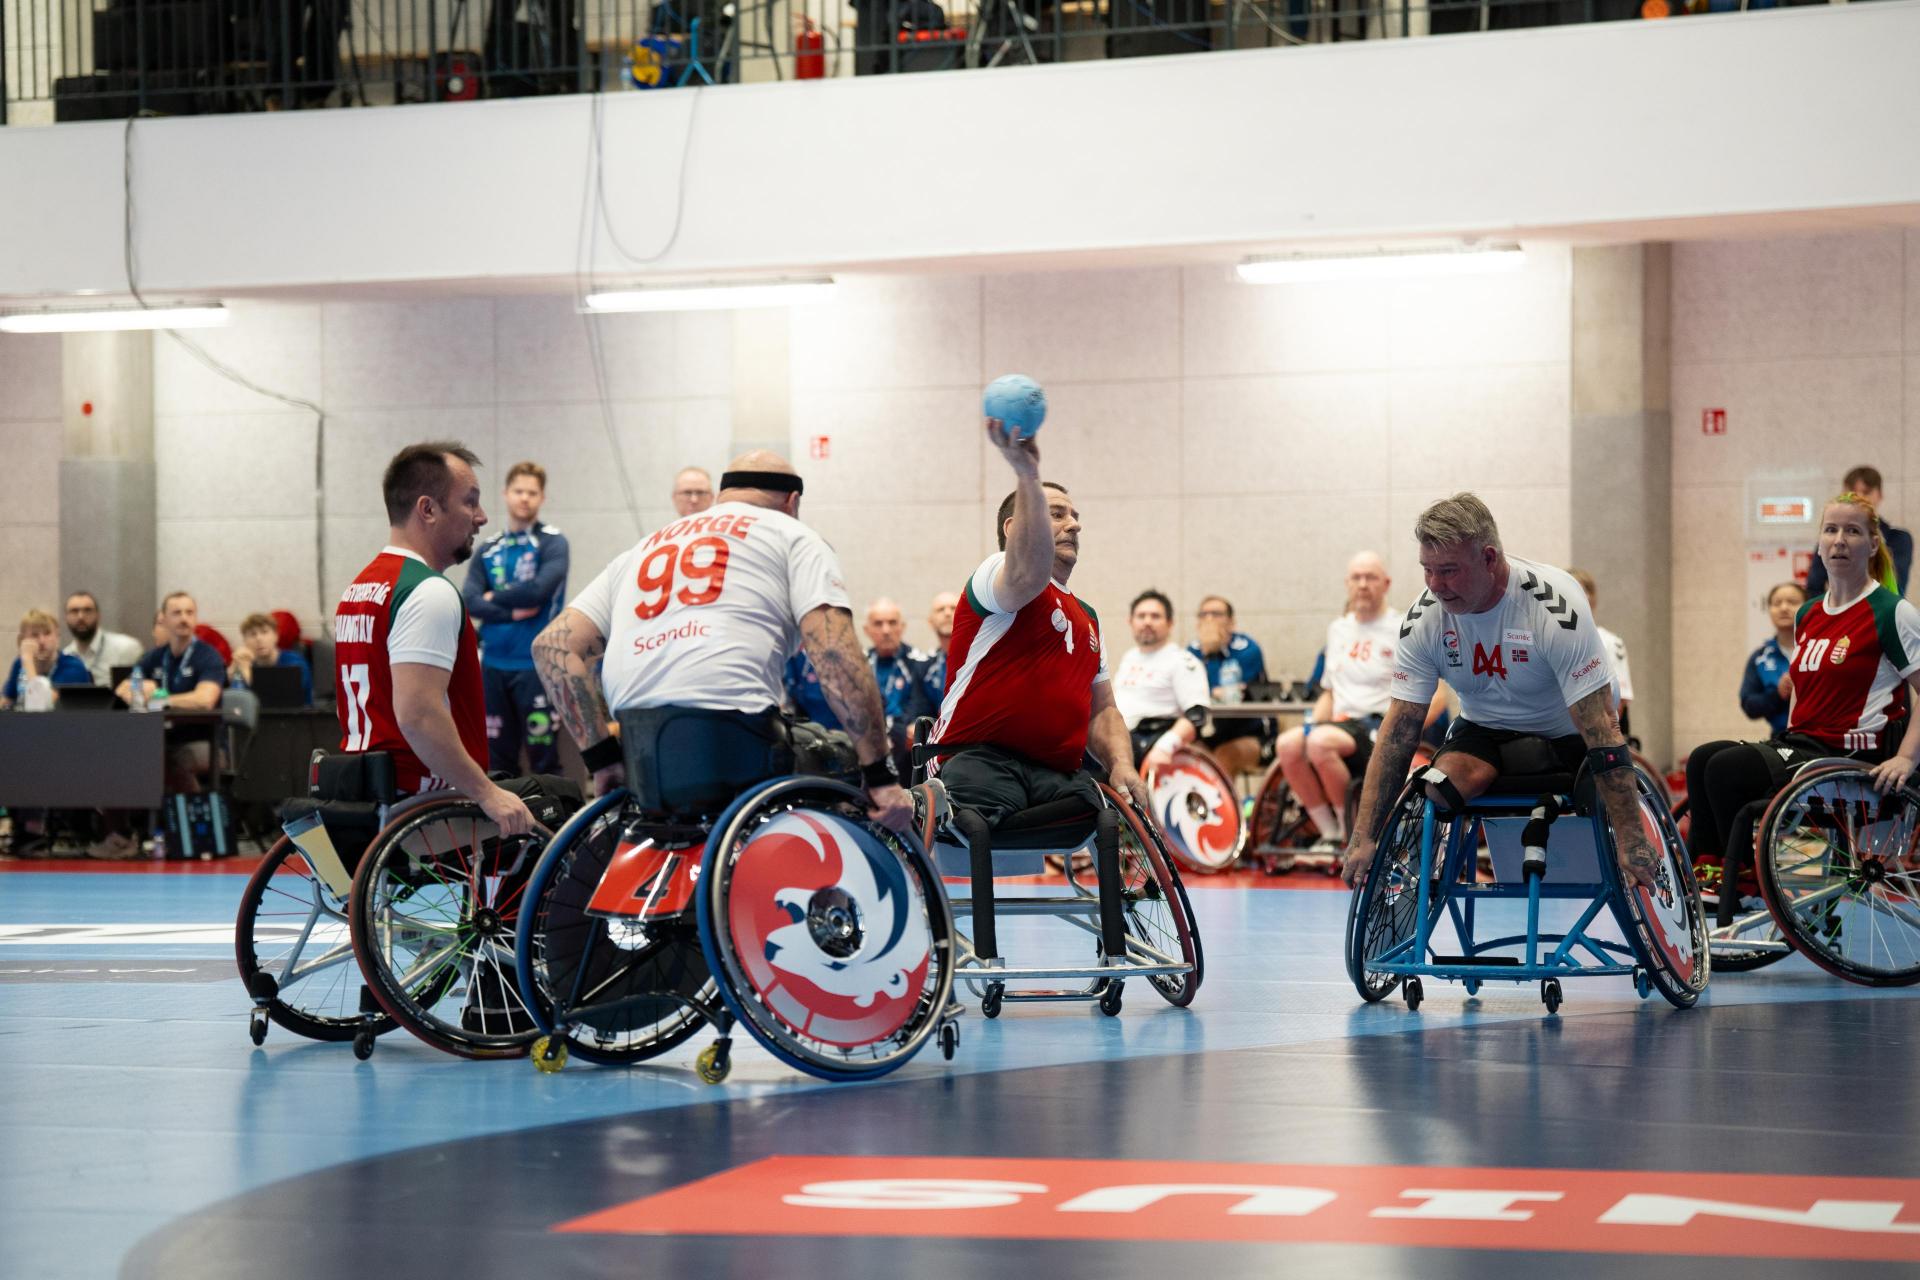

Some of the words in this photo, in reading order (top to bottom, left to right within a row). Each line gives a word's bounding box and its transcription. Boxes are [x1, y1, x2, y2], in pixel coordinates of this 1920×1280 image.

[643, 513, 758, 550] NORGE
[634, 536, 730, 620] 99
[633, 619, 712, 655] Scandic
[1506, 632, 1531, 641] Scandic
[1798, 638, 1831, 672] 10
[1473, 640, 1508, 680] 44
[1571, 656, 1602, 680] Scandic
[341, 663, 373, 752] 17
[632, 855, 686, 909] 4
[783, 1179, 1920, 1233] NIUS
